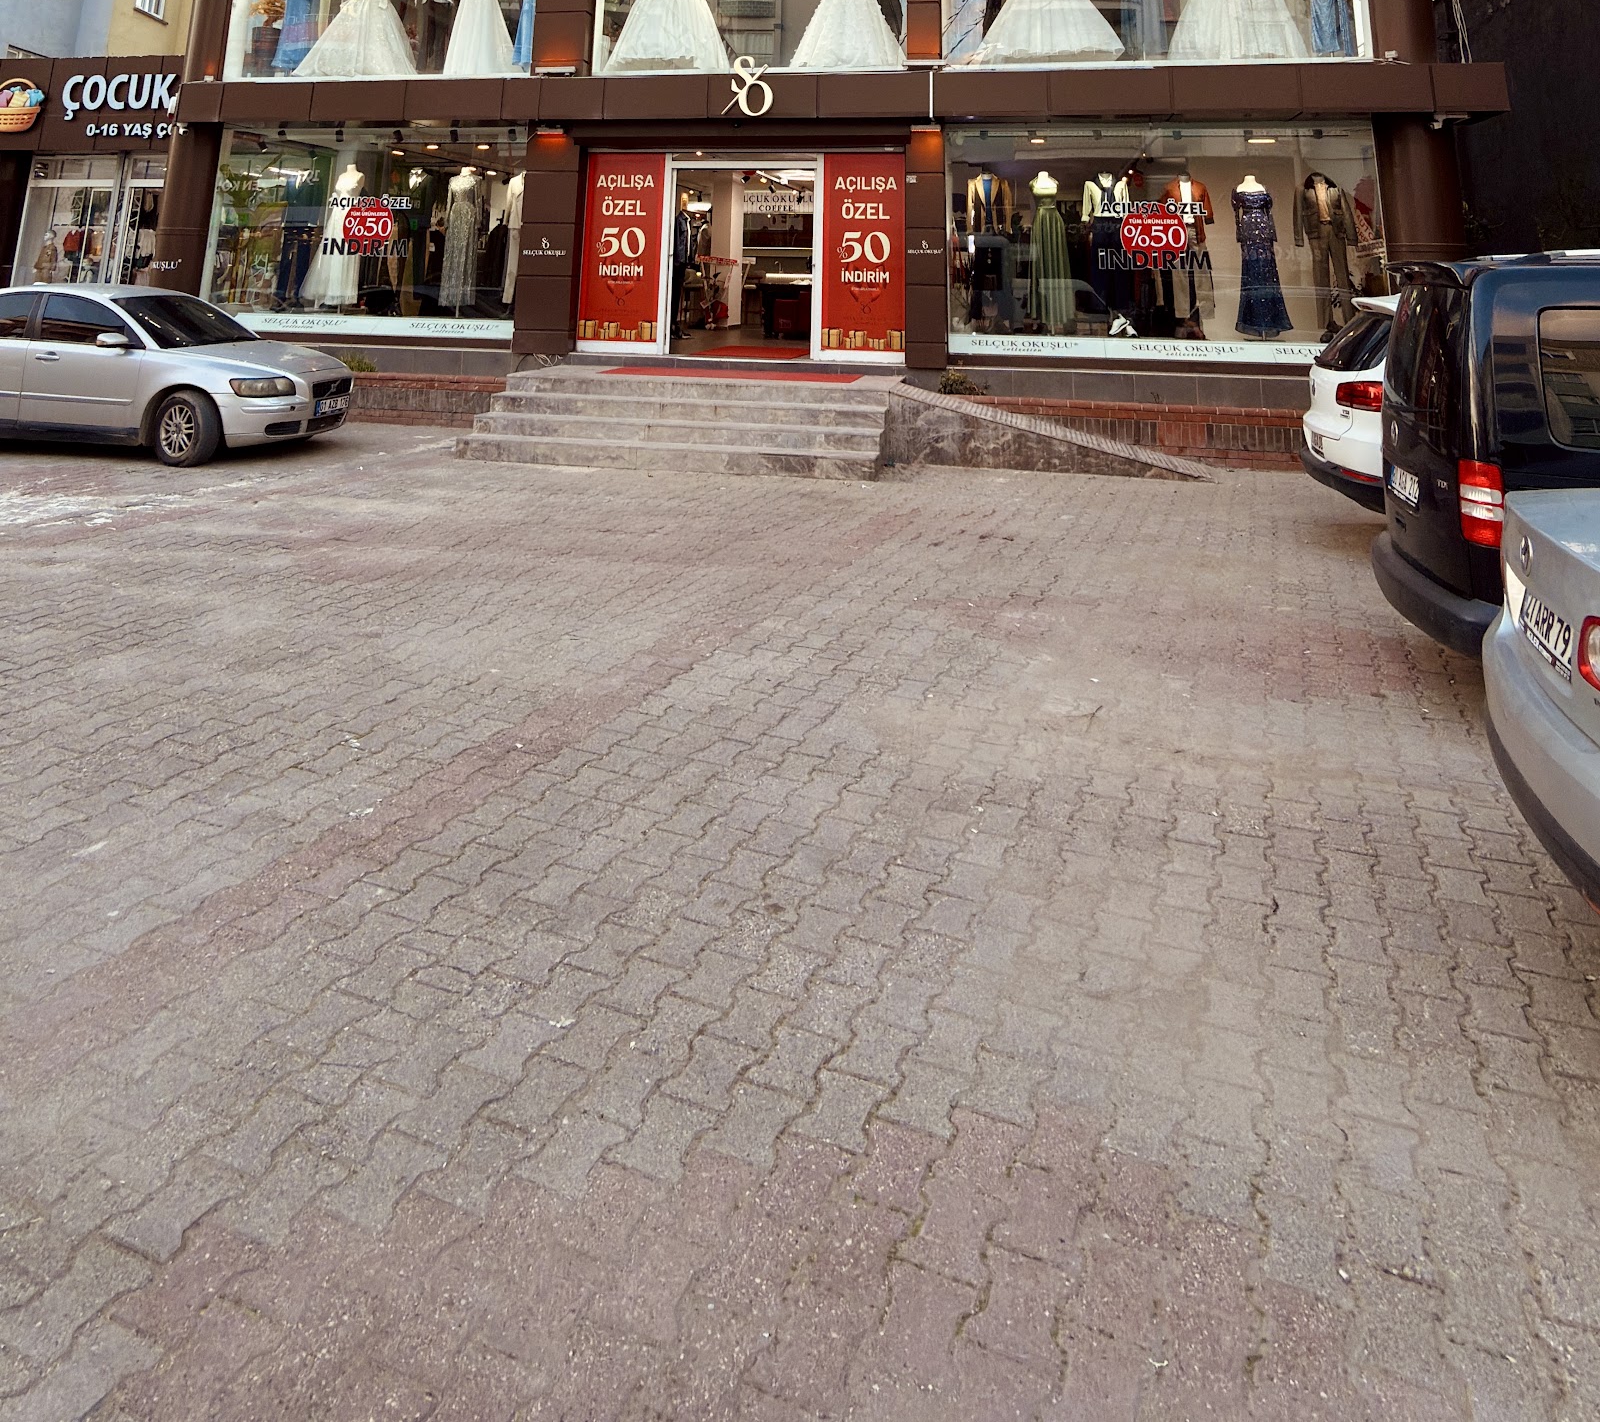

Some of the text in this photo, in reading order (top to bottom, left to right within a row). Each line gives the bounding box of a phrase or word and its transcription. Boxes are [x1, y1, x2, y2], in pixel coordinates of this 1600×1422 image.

[62, 73, 177, 120] ÇOCUK
[86, 123, 118, 137] 0-16
[122, 123, 153, 139] YAŞ
[596, 174, 654, 190] AÇILIŞA
[834, 176, 897, 193] AÇILIŞA
[329, 194, 412, 210] AÇILIŞA ÖZEL
[602, 196, 646, 216] ÖZEL
[841, 199, 890, 220] ÖZEL
[1100, 198, 1207, 218] AÇILIŞA ÖZEL
[345, 217, 392, 236] %50
[1124, 225, 1185, 248] %50
[598, 262, 644, 277] İNDİRİM
[841, 268, 890, 283] İNDİRİM
[971, 339, 1018, 348] SELÇUK
[1131, 343, 1182, 353] SELÇUK
